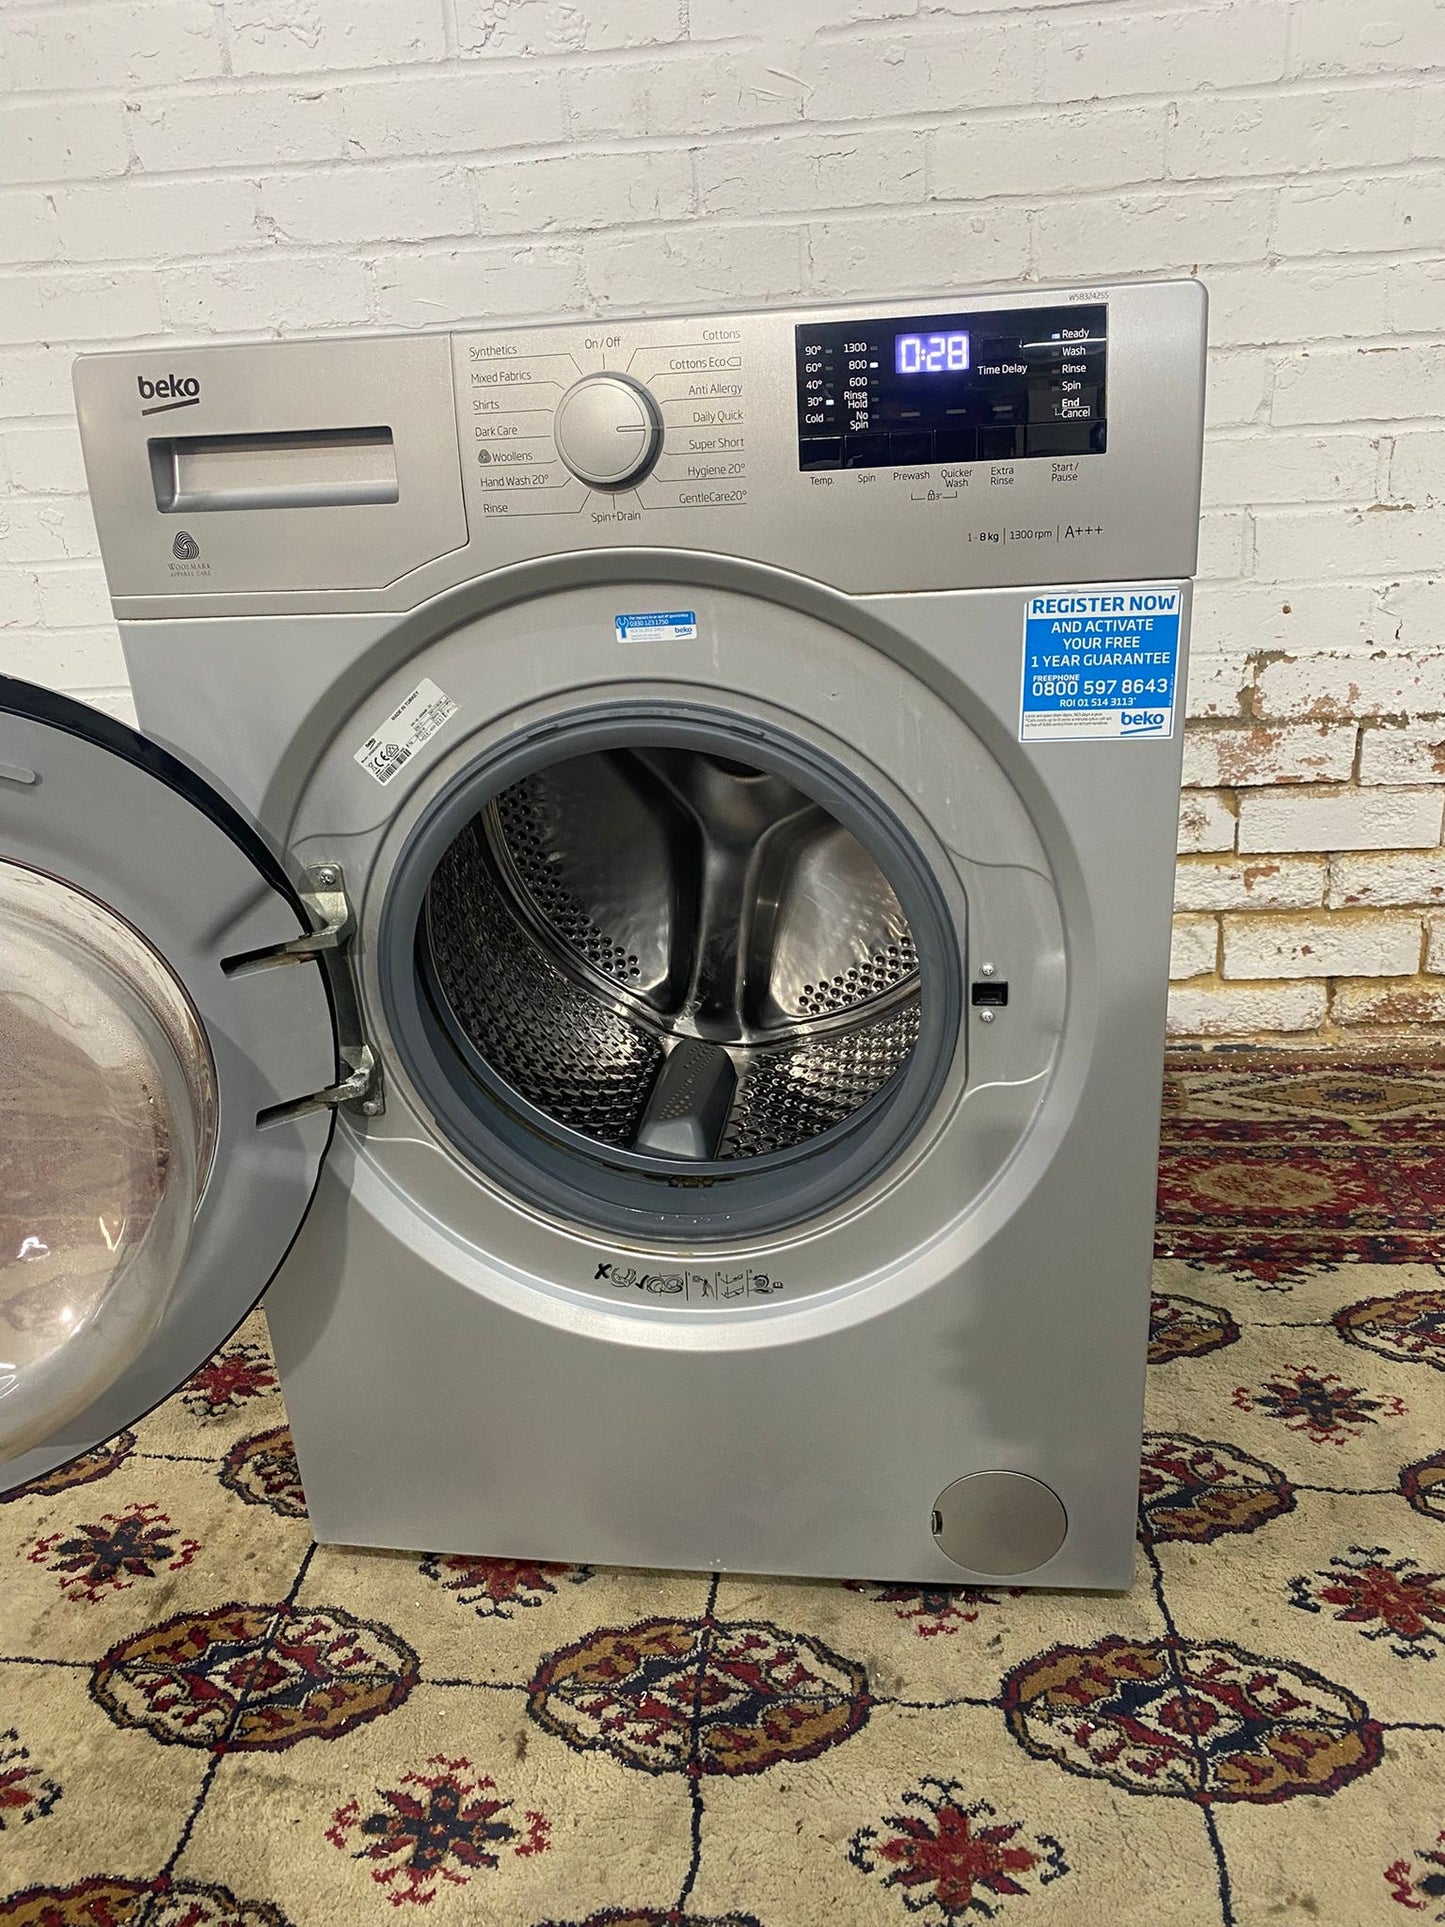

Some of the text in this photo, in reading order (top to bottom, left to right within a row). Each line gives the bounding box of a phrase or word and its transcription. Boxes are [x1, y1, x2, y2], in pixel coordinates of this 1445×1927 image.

[702, 329, 741, 341] Cottons
[1062, 328, 1090, 341] Ready
[584, 338, 599, 349] On
[606, 336, 621, 348] Off
[843, 342, 867, 353] 1300
[469, 345, 517, 358] Synthetics
[805, 346, 822, 356] 90°
[900, 336, 969, 373] 0:28
[1062, 346, 1087, 357] Wash
[669, 357, 726, 371] Cottons Eco
[805, 362, 822, 373] 60°
[848, 360, 868, 371] 800
[977, 363, 1028, 376] Time Delay
[1062, 363, 1087, 374] Rinse
[471, 370, 532, 383] Mixed Fabrics
[849, 377, 868, 387] 600
[138, 374, 200, 400] beko
[688, 382, 743, 396] Anti Allergy
[806, 380, 822, 390] 40°
[1062, 380, 1082, 393] Spin
[843, 390, 868, 401] Rinse
[473, 399, 500, 411] Shirts
[806, 397, 823, 407] 30°
[848, 399, 868, 409] Hold
[1062, 398, 1080, 408] End
[693, 409, 744, 424] Daily Quick
[805, 413, 824, 424] Cold
[856, 411, 869, 421] No
[1061, 408, 1090, 418] Cancel
[475, 425, 518, 437] Dark Care
[849, 419, 869, 432] Spin
[689, 437, 744, 452] Super Short
[491, 450, 533, 462] Woollens
[687, 463, 746, 478] Hygiene 20°
[893, 470, 930, 481] Prewash
[940, 469, 973, 480] Quicker
[990, 466, 1014, 476] Extra
[480, 473, 549, 488] Hand Wash 20°
[810, 476, 835, 488] Temp.
[857, 473, 876, 485] Spin
[945, 478, 969, 488] Wash
[990, 476, 1015, 487] Rinse
[1051, 472, 1078, 482] Pause
[484, 503, 508, 514] Rinse
[591, 510, 641, 524] Spin+Drain
[979, 532, 986, 541] 8
[987, 532, 999, 543] kg
[1010, 530, 1052, 541] 1300 rpm
[1064, 525, 1104, 539] A+++
[1032, 594, 1176, 614] REGISTER NOW
[1051, 619, 1154, 634] AND ACTIVATE
[1062, 636, 1140, 650] YOUR FREE
[1031, 652, 1171, 668] 1 YEAR GUARANTEE
[1033, 673, 1080, 682] FREEPHONE
[1032, 681, 1078, 696] 0800
[1083, 679, 1117, 695] 597
[1121, 678, 1168, 694] 8643
[1060, 699, 1077, 708] ROI
[1077, 699, 1089, 707] 01
[1091, 698, 1108, 706] 514
[1121, 711, 1165, 726] beko
